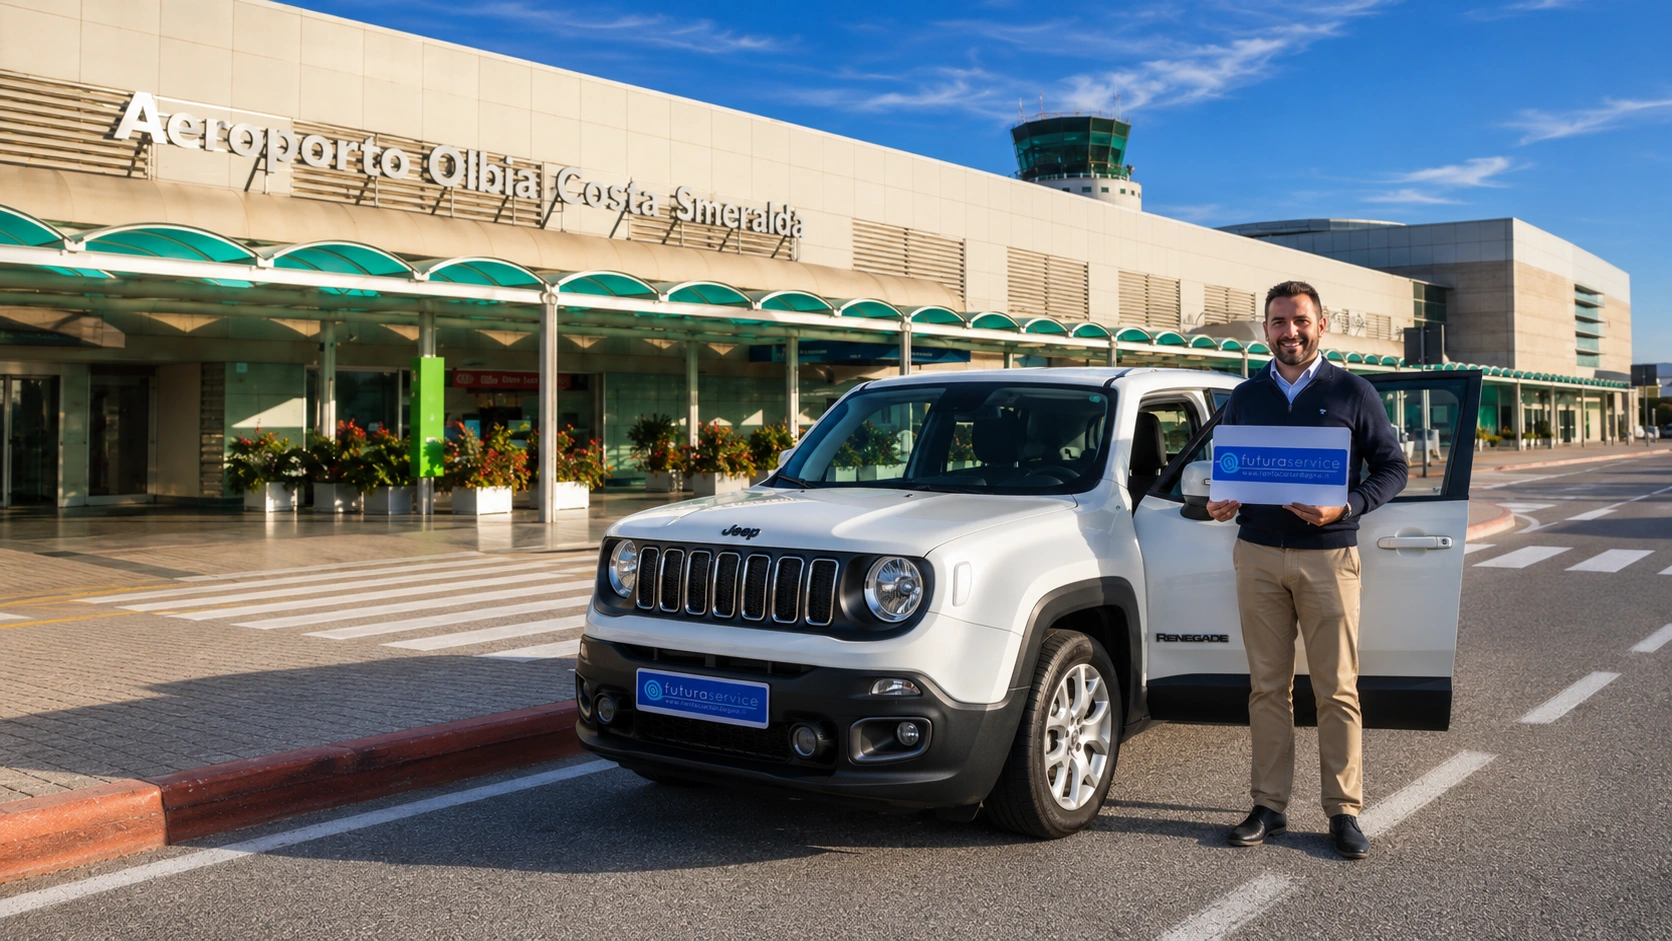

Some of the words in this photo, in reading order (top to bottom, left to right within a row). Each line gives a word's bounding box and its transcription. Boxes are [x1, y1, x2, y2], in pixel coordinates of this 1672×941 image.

[113, 90, 410, 174] Aeroporto
[428, 144, 538, 200] Olbia
[555, 166, 661, 218] Costa
[674, 185, 804, 239] Smeralda
[1241, 454, 1341, 470] futuraservice
[721, 524, 761, 541] Jeep
[1155, 632, 1230, 643] RENEGADE
[664, 682, 759, 707] futuraservice
